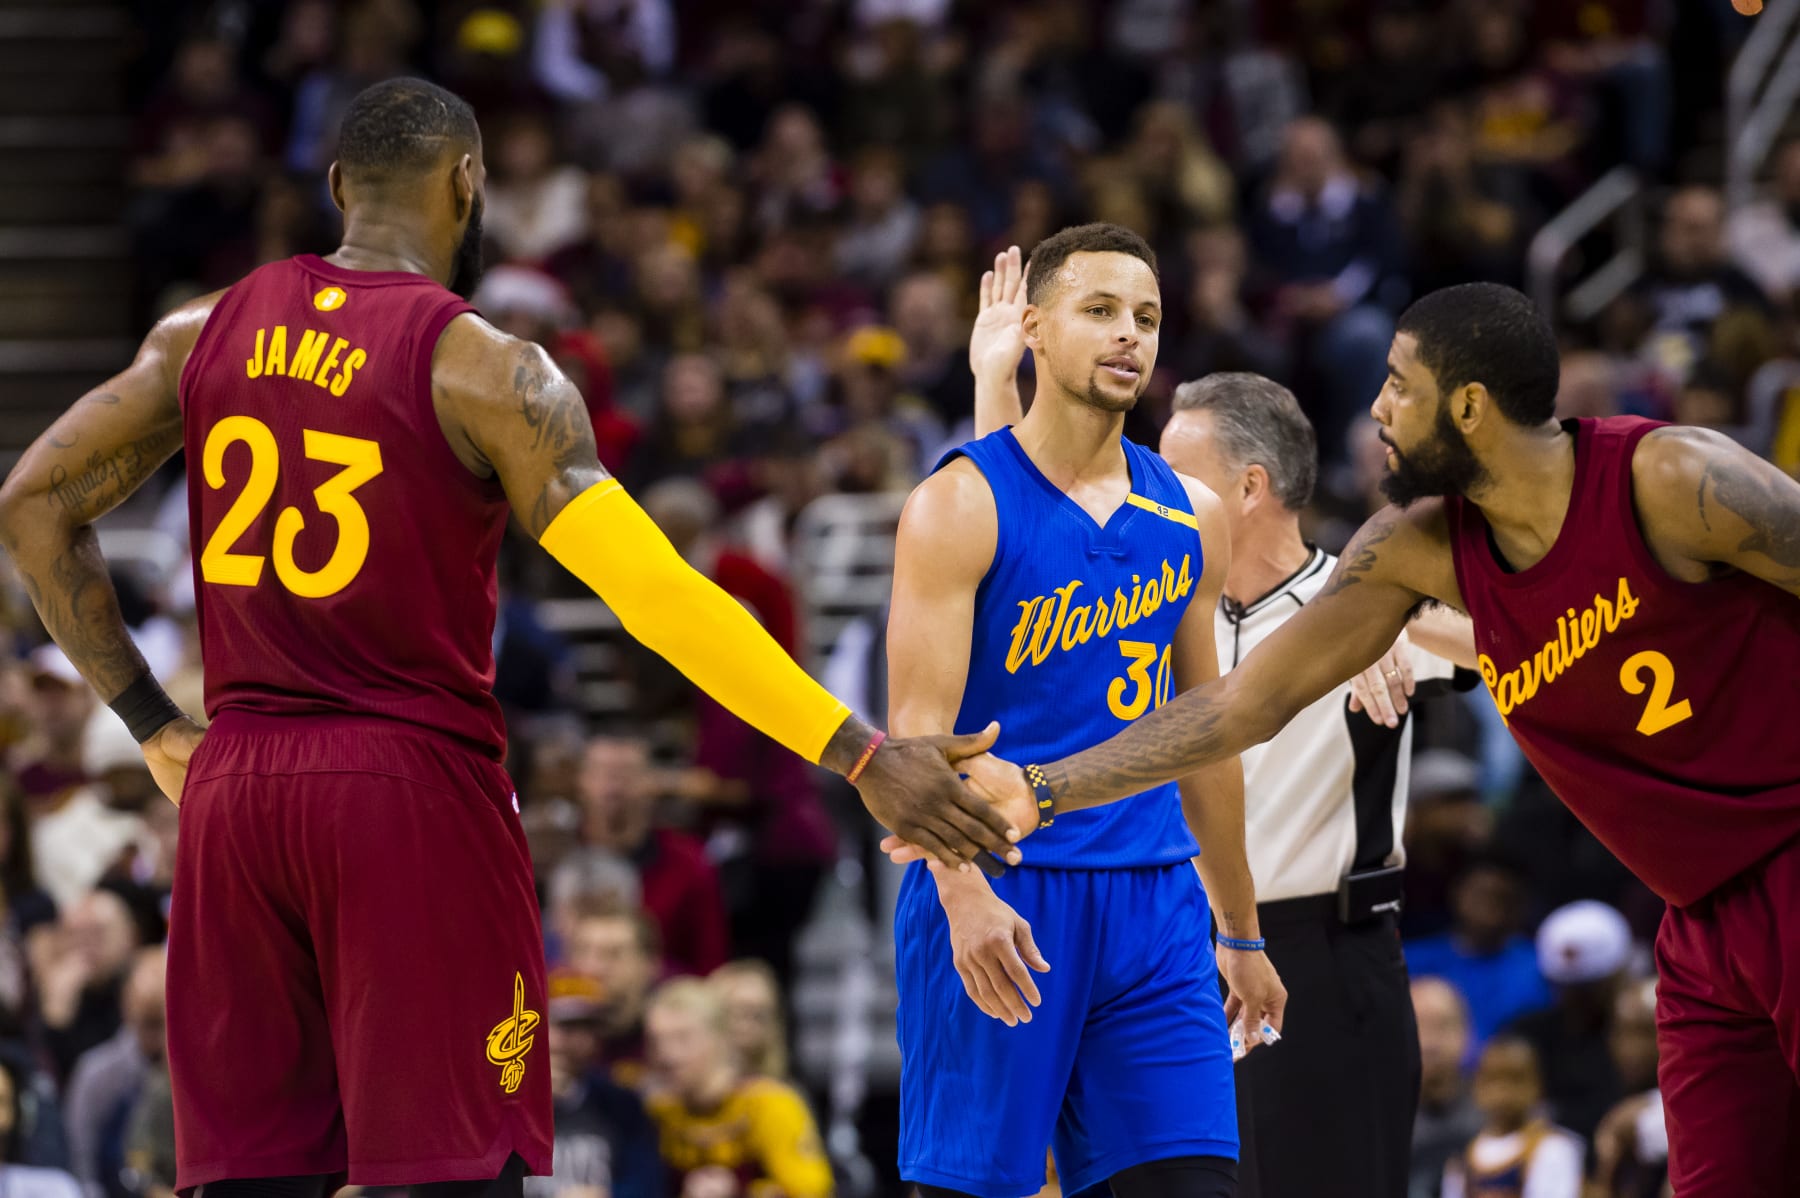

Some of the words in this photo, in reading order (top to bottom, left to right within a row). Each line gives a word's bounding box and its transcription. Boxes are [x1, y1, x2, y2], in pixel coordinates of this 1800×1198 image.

[246, 325, 367, 397] JAMES
[200, 415, 384, 599] 23
[1004, 553, 1194, 675] Warriors
[1477, 576, 1640, 728] Cavaliers
[1106, 639, 1172, 721] 30
[1618, 650, 1694, 737] 2
